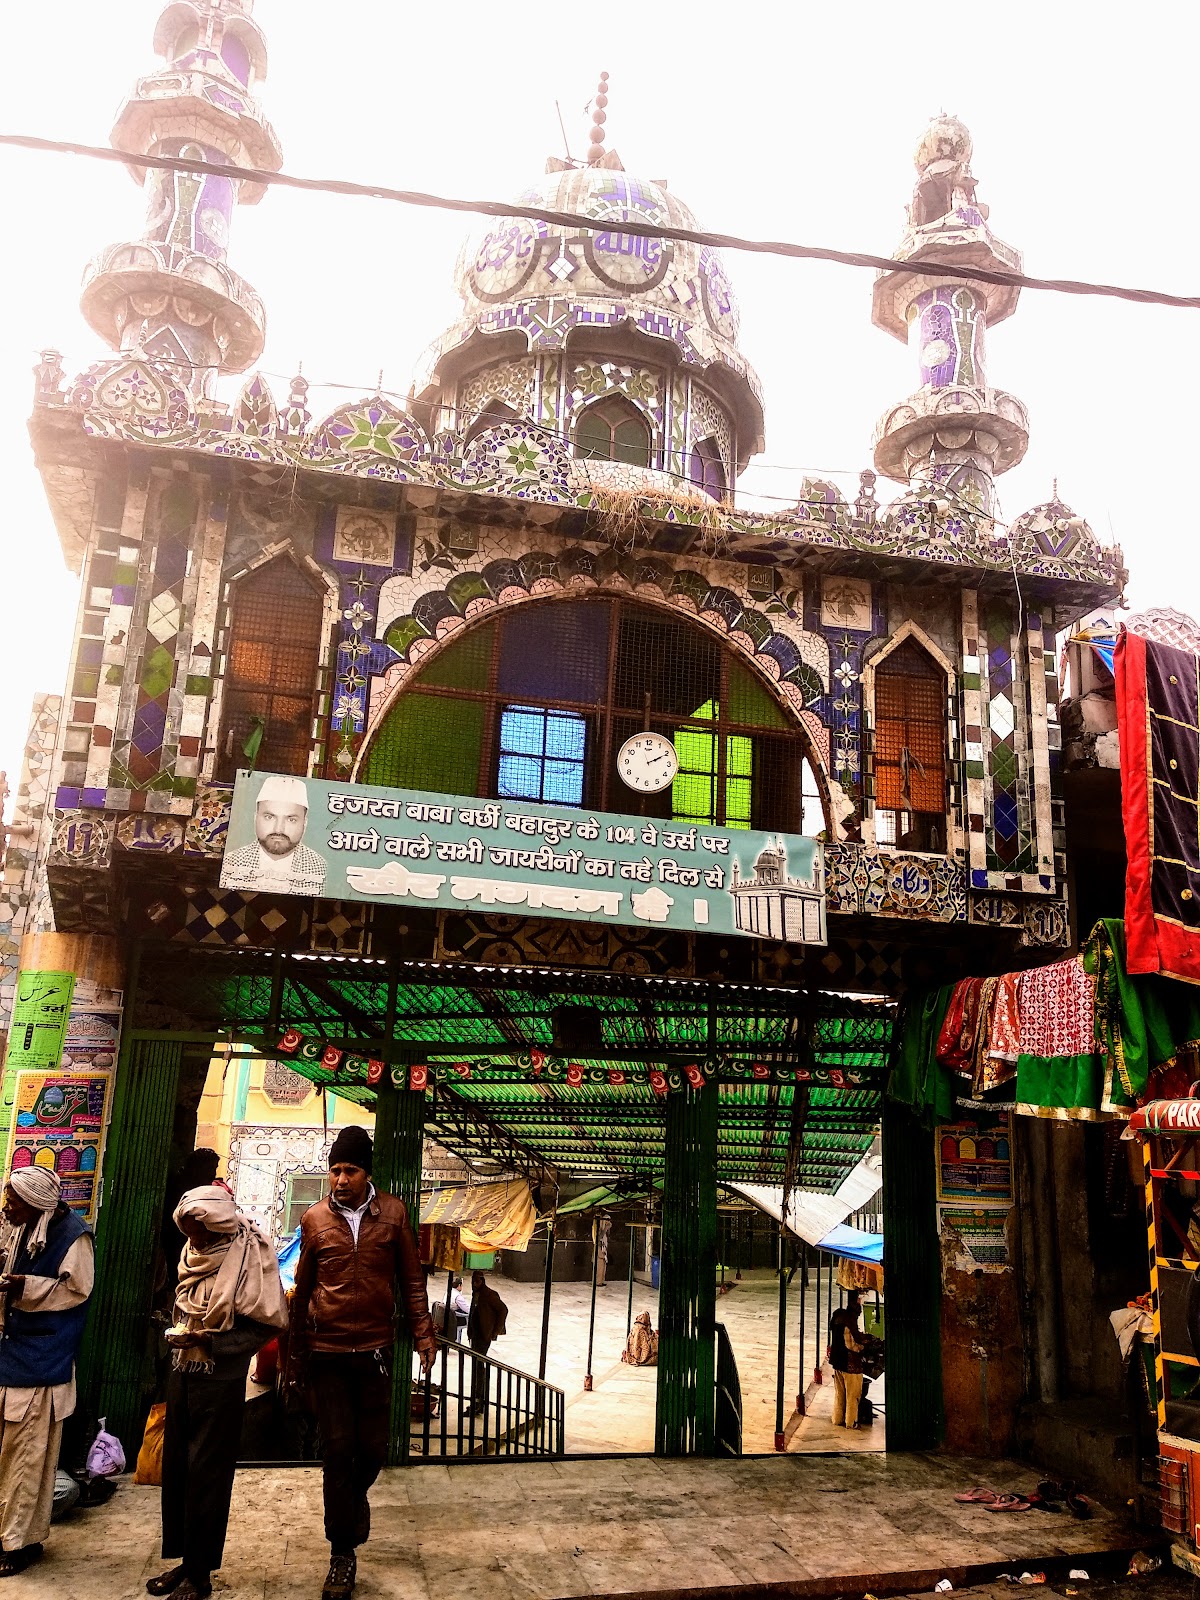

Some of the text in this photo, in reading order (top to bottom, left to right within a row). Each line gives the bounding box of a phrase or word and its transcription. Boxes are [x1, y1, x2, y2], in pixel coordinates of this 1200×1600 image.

[327, 793, 401, 819] हजरत
[407, 801, 454, 825] बाबा
[505, 813, 573, 845] बहादुर
[576, 816, 601, 840] के
[606, 826, 636, 845] 104
[641, 823, 658, 847] वे
[662, 828, 697, 850] उर्स
[700, 836, 730, 855] पर
[327, 827, 725, 889] आने वाले सभी जायरीनों का तहे दिल से
